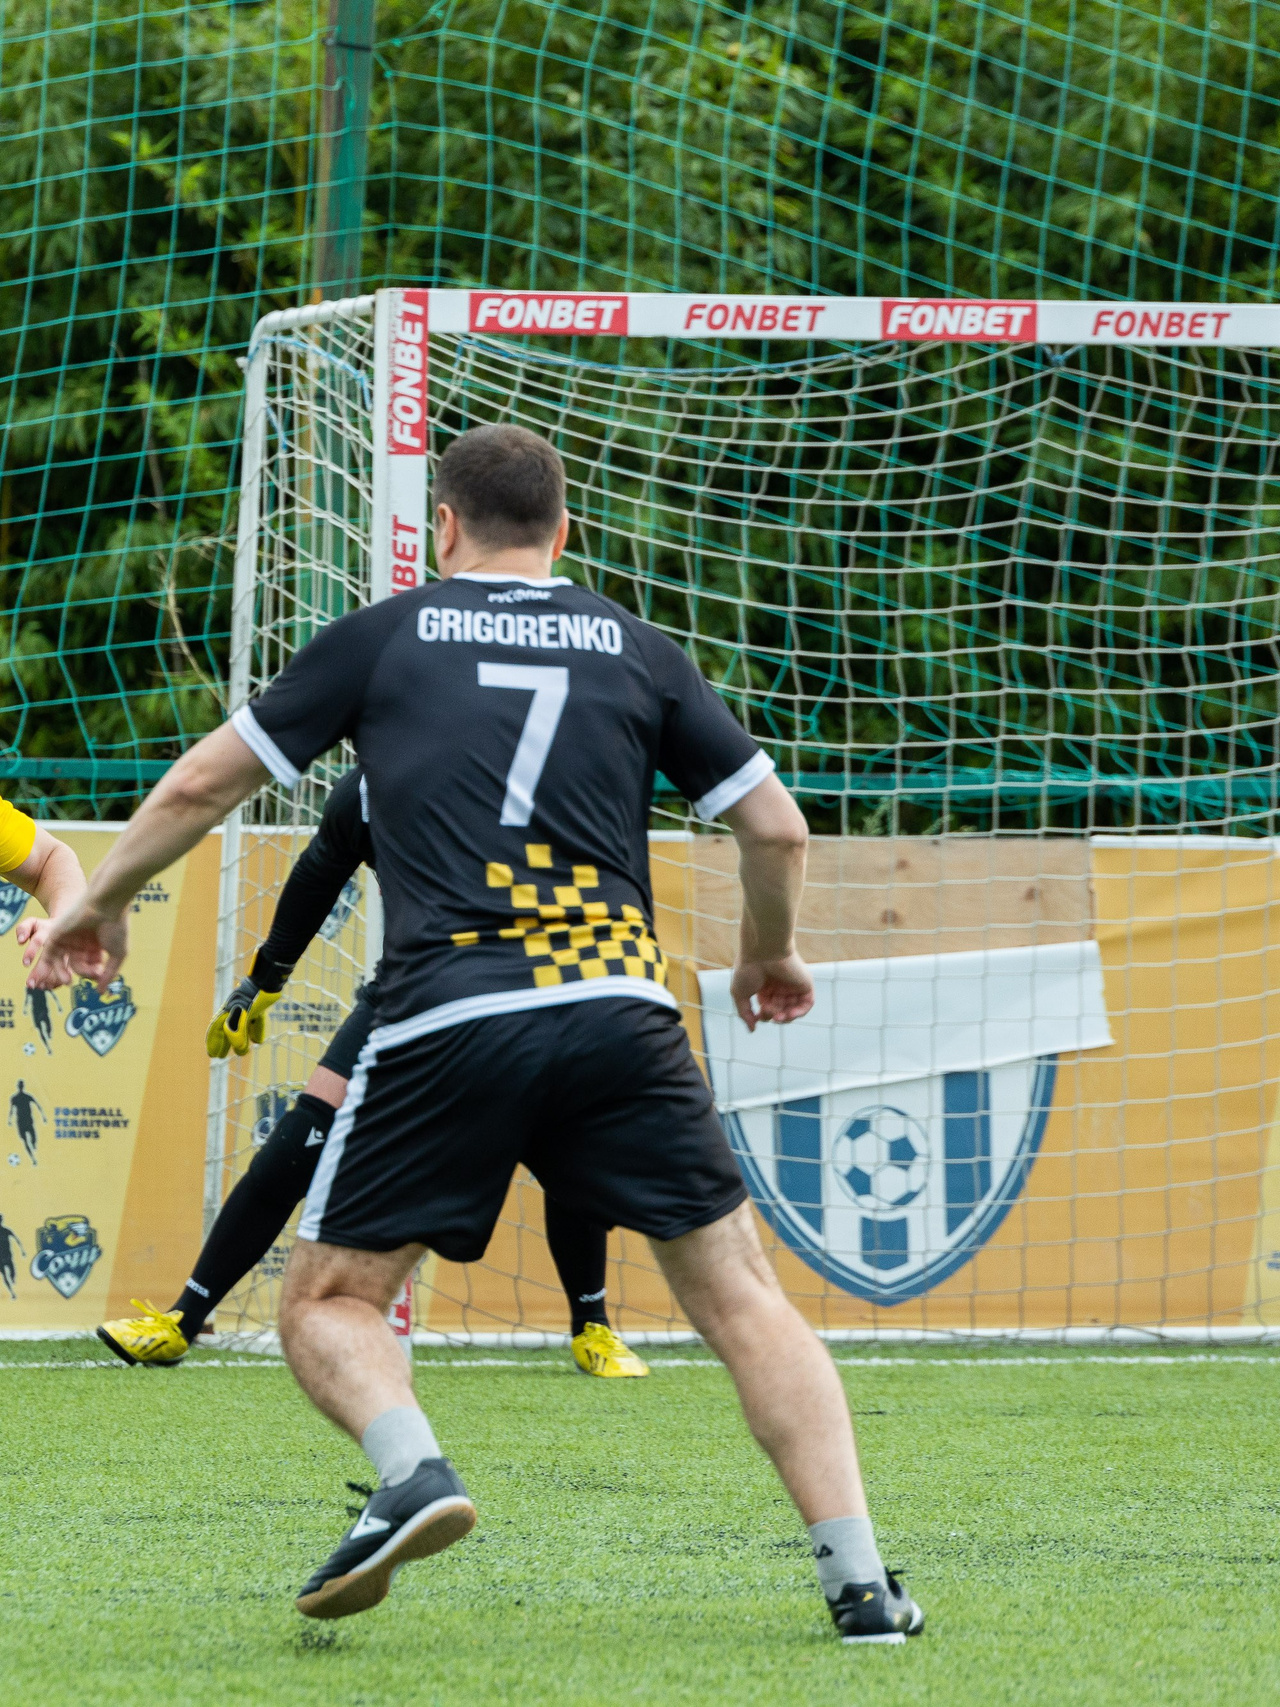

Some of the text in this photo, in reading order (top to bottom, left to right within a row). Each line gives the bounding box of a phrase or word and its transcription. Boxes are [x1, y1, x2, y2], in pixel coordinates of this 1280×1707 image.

[475, 297, 623, 330] FONBET
[685, 303, 825, 332] FONBET
[886, 304, 1032, 337] FONBET
[1093, 310, 1230, 338] FONBET
[393, 291, 424, 449] FONBET
[392, 515, 418, 594] BET
[417, 606, 623, 655] GRIGORENKO
[477, 661, 569, 827] 7
[54, 1107, 124, 1117] FOOTBALL
[54, 1118, 130, 1128] TERRITORY
[54, 1129, 101, 1139] SIRIUS
